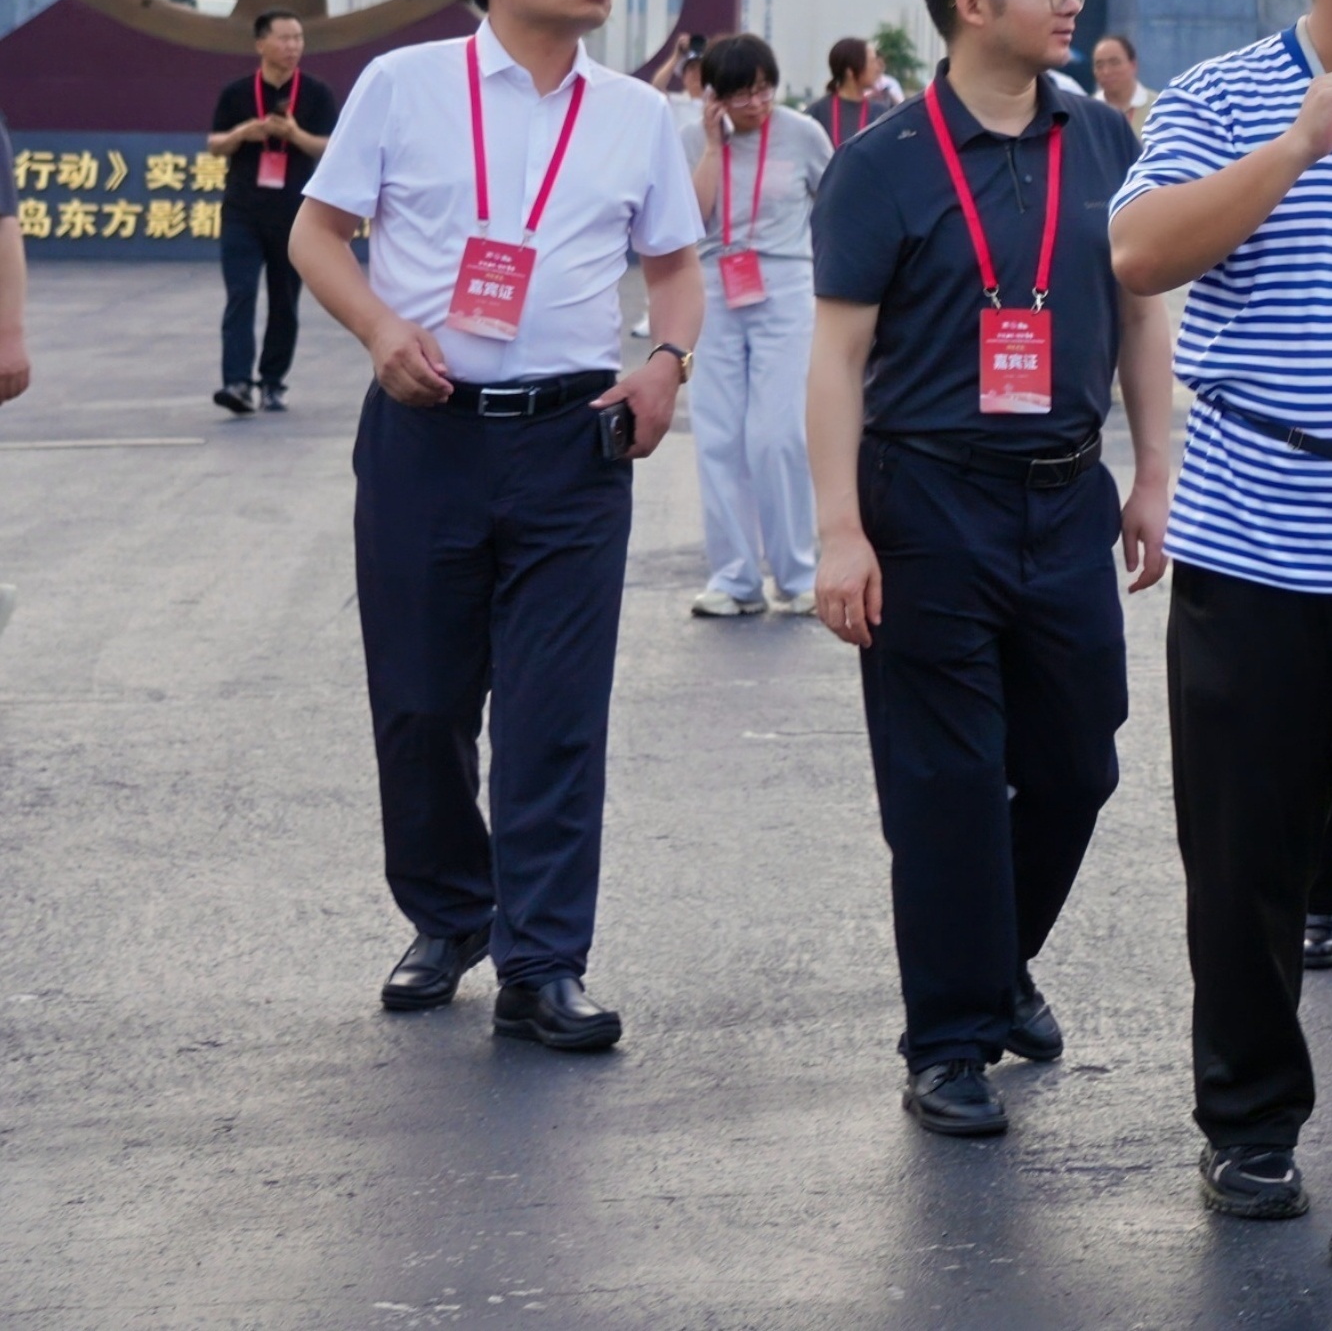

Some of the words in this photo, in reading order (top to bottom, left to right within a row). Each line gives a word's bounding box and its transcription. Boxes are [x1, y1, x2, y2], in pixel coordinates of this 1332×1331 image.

[14, 149, 230, 191] 行动》实景
[18, 198, 224, 240] 岛东方影都
[467, 278, 516, 301] 嘉宾证
[993, 353, 1039, 370] 嘉宾证
